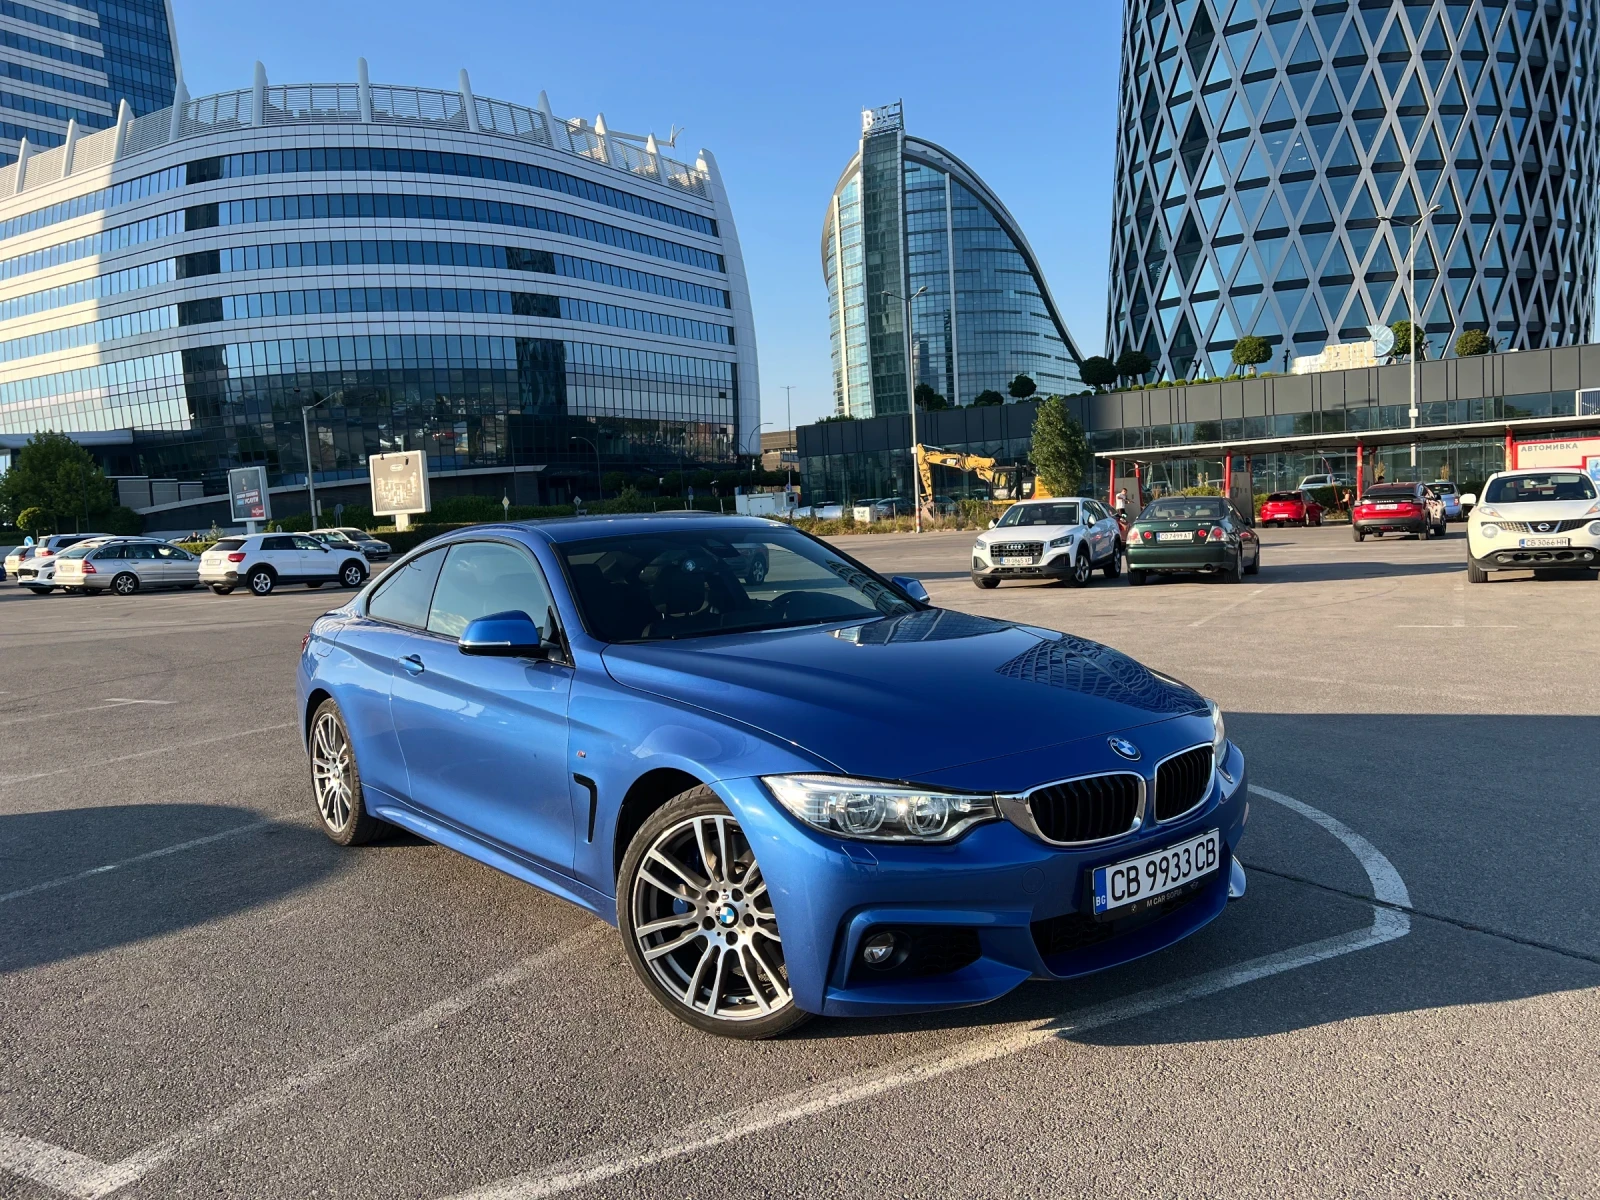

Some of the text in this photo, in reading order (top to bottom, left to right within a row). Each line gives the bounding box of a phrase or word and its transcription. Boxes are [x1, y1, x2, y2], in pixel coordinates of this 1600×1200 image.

[1521, 442, 1578, 452] АВТОМИВКА
[1111, 837, 1217, 901] CB 9933 CB
[1096, 895, 1106, 906] BG
[1146, 899, 1153, 908] M
[1153, 894, 1166, 905] CAR
